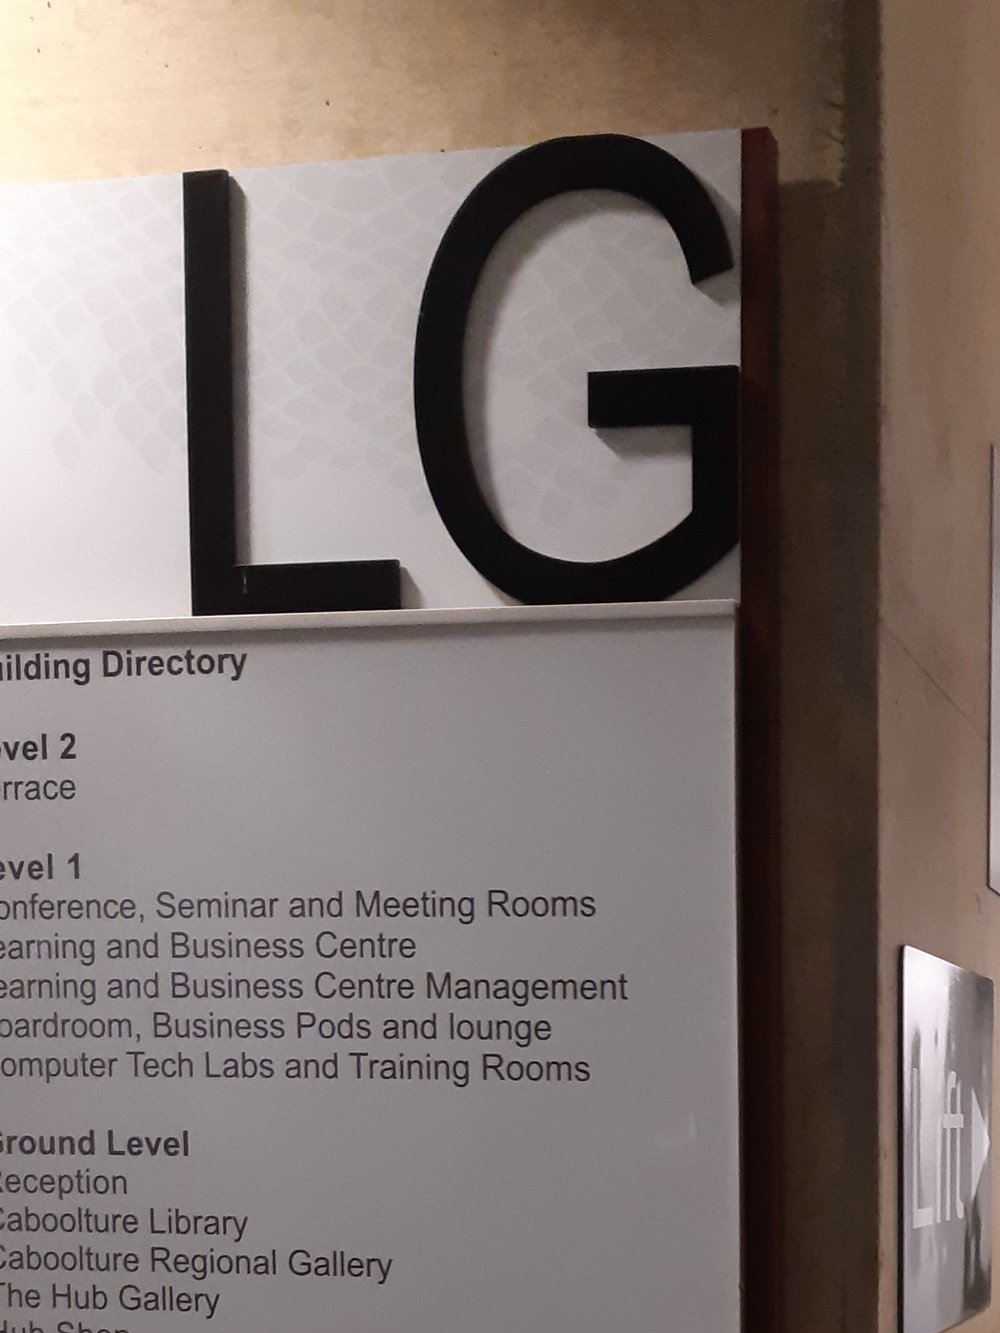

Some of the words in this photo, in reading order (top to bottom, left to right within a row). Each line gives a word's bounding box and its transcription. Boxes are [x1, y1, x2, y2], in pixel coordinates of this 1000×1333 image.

[183, 134, 741, 616] LG
[0, 653, 90, 685] ilding
[103, 649, 247, 681] Directory
[0, 733, 47, 760] vel
[60, 733, 76, 759] 2
[0, 779, 76, 800] rrace
[67, 853, 80, 879] 1
[0, 892, 144, 923] onference,
[156, 891, 279, 919] Seminar
[289, 890, 343, 918] and
[355, 890, 474, 925] Meeting
[487, 889, 596, 917] Rooms
[107, 932, 159, 959] and
[171, 931, 304, 959] Business
[316, 931, 416, 958] Centre
[107, 972, 159, 999] and
[171, 971, 303, 999] Business
[315, 971, 414, 999] Centre
[426, 971, 628, 1007] Management
[0, 1012, 141, 1042] oardroom,
[153, 1012, 285, 1039] Business
[297, 1012, 371, 1039] Pods
[382, 1013, 437, 1040] and
[450, 1013, 551, 1047] lounge
[1, 1053, 118, 1083] omputer
[126, 1051, 193, 1078] Tech
[205, 1051, 274, 1079] Labs
[285, 1053, 338, 1080] and
[349, 1053, 469, 1088] Training
[482, 1054, 590, 1081] Rooms
[0, 1130, 95, 1155] round
[107, 1130, 190, 1156] Level
[912, 1065, 963, 1230] Lift
[0, 1168, 128, 1199] eception
[150, 1208, 248, 1242] Library
[151, 1247, 276, 1280] Regional
[289, 1250, 393, 1284] Gallery
[52, 1283, 107, 1310] Hub
[119, 1284, 219, 1319] Gallery
